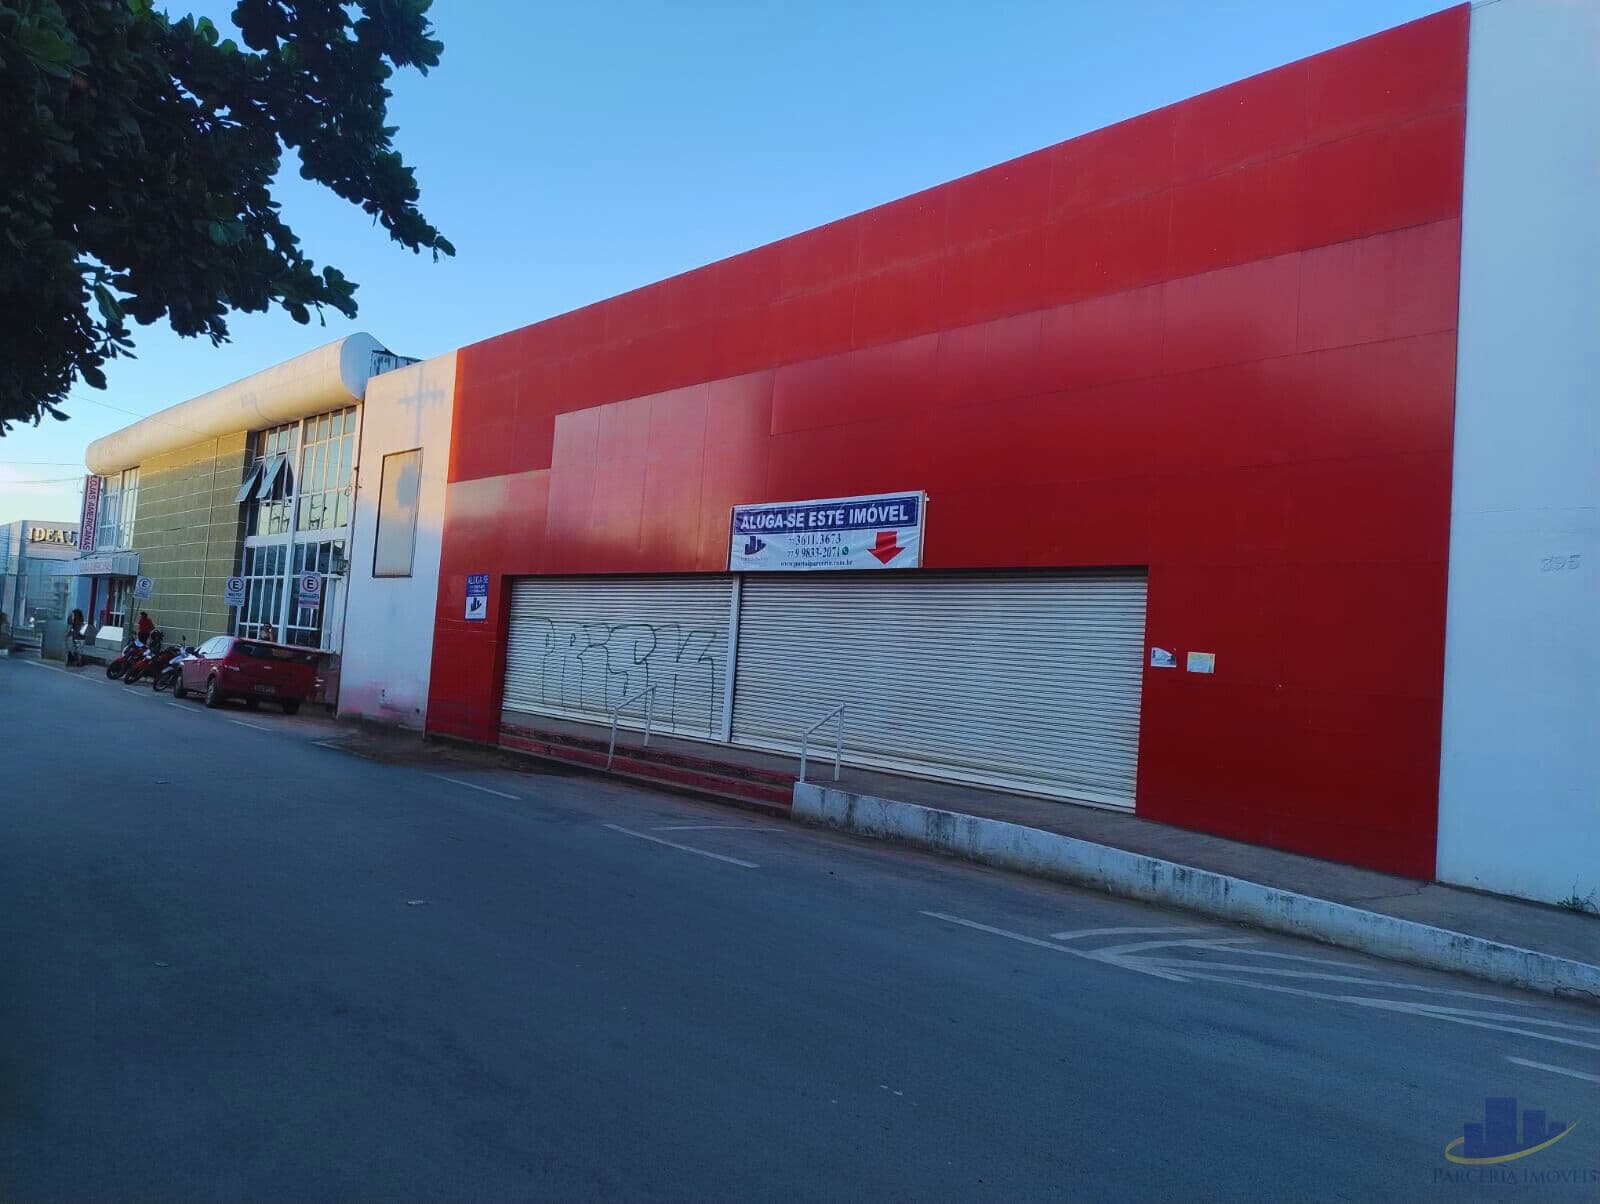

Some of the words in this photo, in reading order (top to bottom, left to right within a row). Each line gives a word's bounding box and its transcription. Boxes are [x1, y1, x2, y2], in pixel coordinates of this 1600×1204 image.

[88, 475, 98, 500] LOJAS
[83, 502, 96, 551] AMERICANAS
[740, 512, 805, 530] ALUGA-SE
[808, 509, 845, 526] ESTE
[849, 504, 909, 525] IMÓVEL
[28, 527, 76, 546] IDEAL
[801, 546, 840, 558] 9833-2071
[232, 580, 240, 589] E
[307, 579, 314, 589] E
